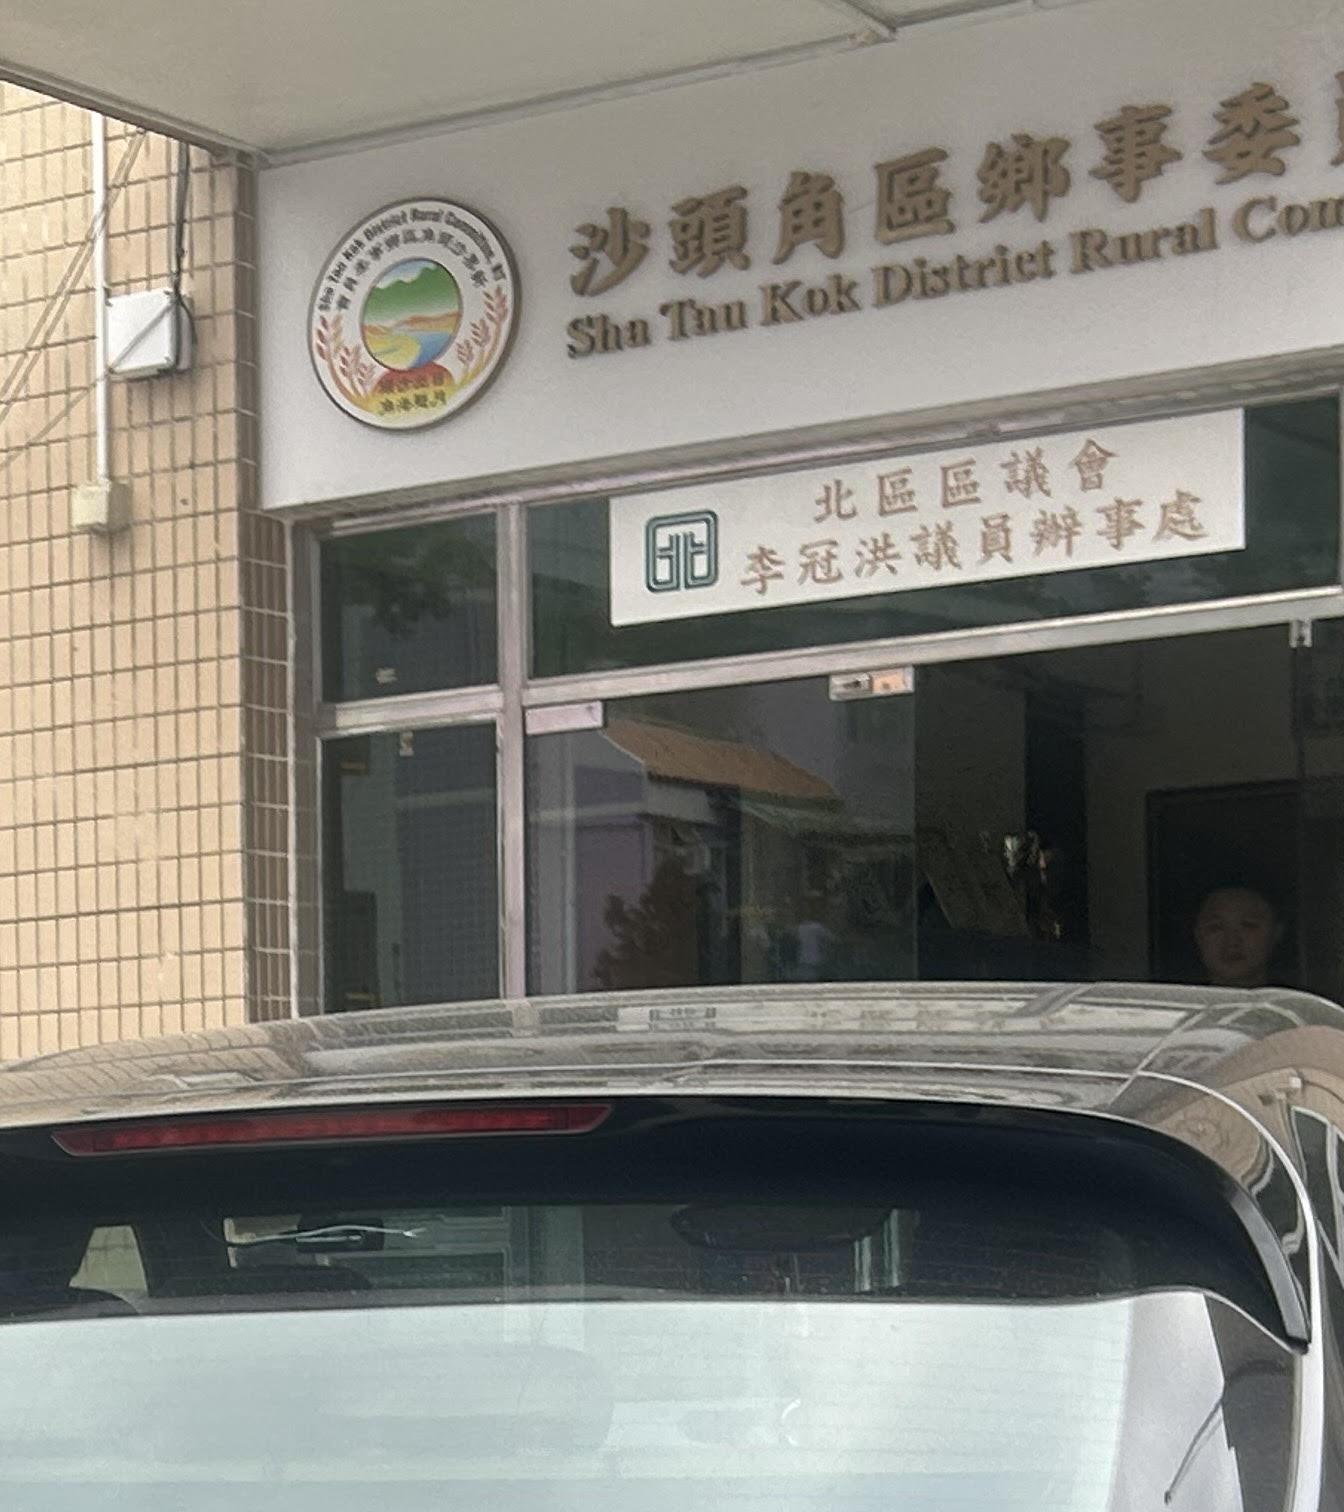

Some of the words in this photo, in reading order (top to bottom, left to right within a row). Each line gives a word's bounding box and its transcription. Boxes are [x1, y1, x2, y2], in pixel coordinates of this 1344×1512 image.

[568, 71, 1344, 297] 沙頭角區鄉事委
[566, 312, 652, 359] Sha
[659, 298, 749, 341] Tau
[758, 272, 862, 326] Kok
[869, 239, 1057, 308] District
[1068, 208, 1219, 276] Rural
[739, 489, 1210, 596] 李冠洪議員辦事處
[814, 437, 1120, 525] 北區區議會
